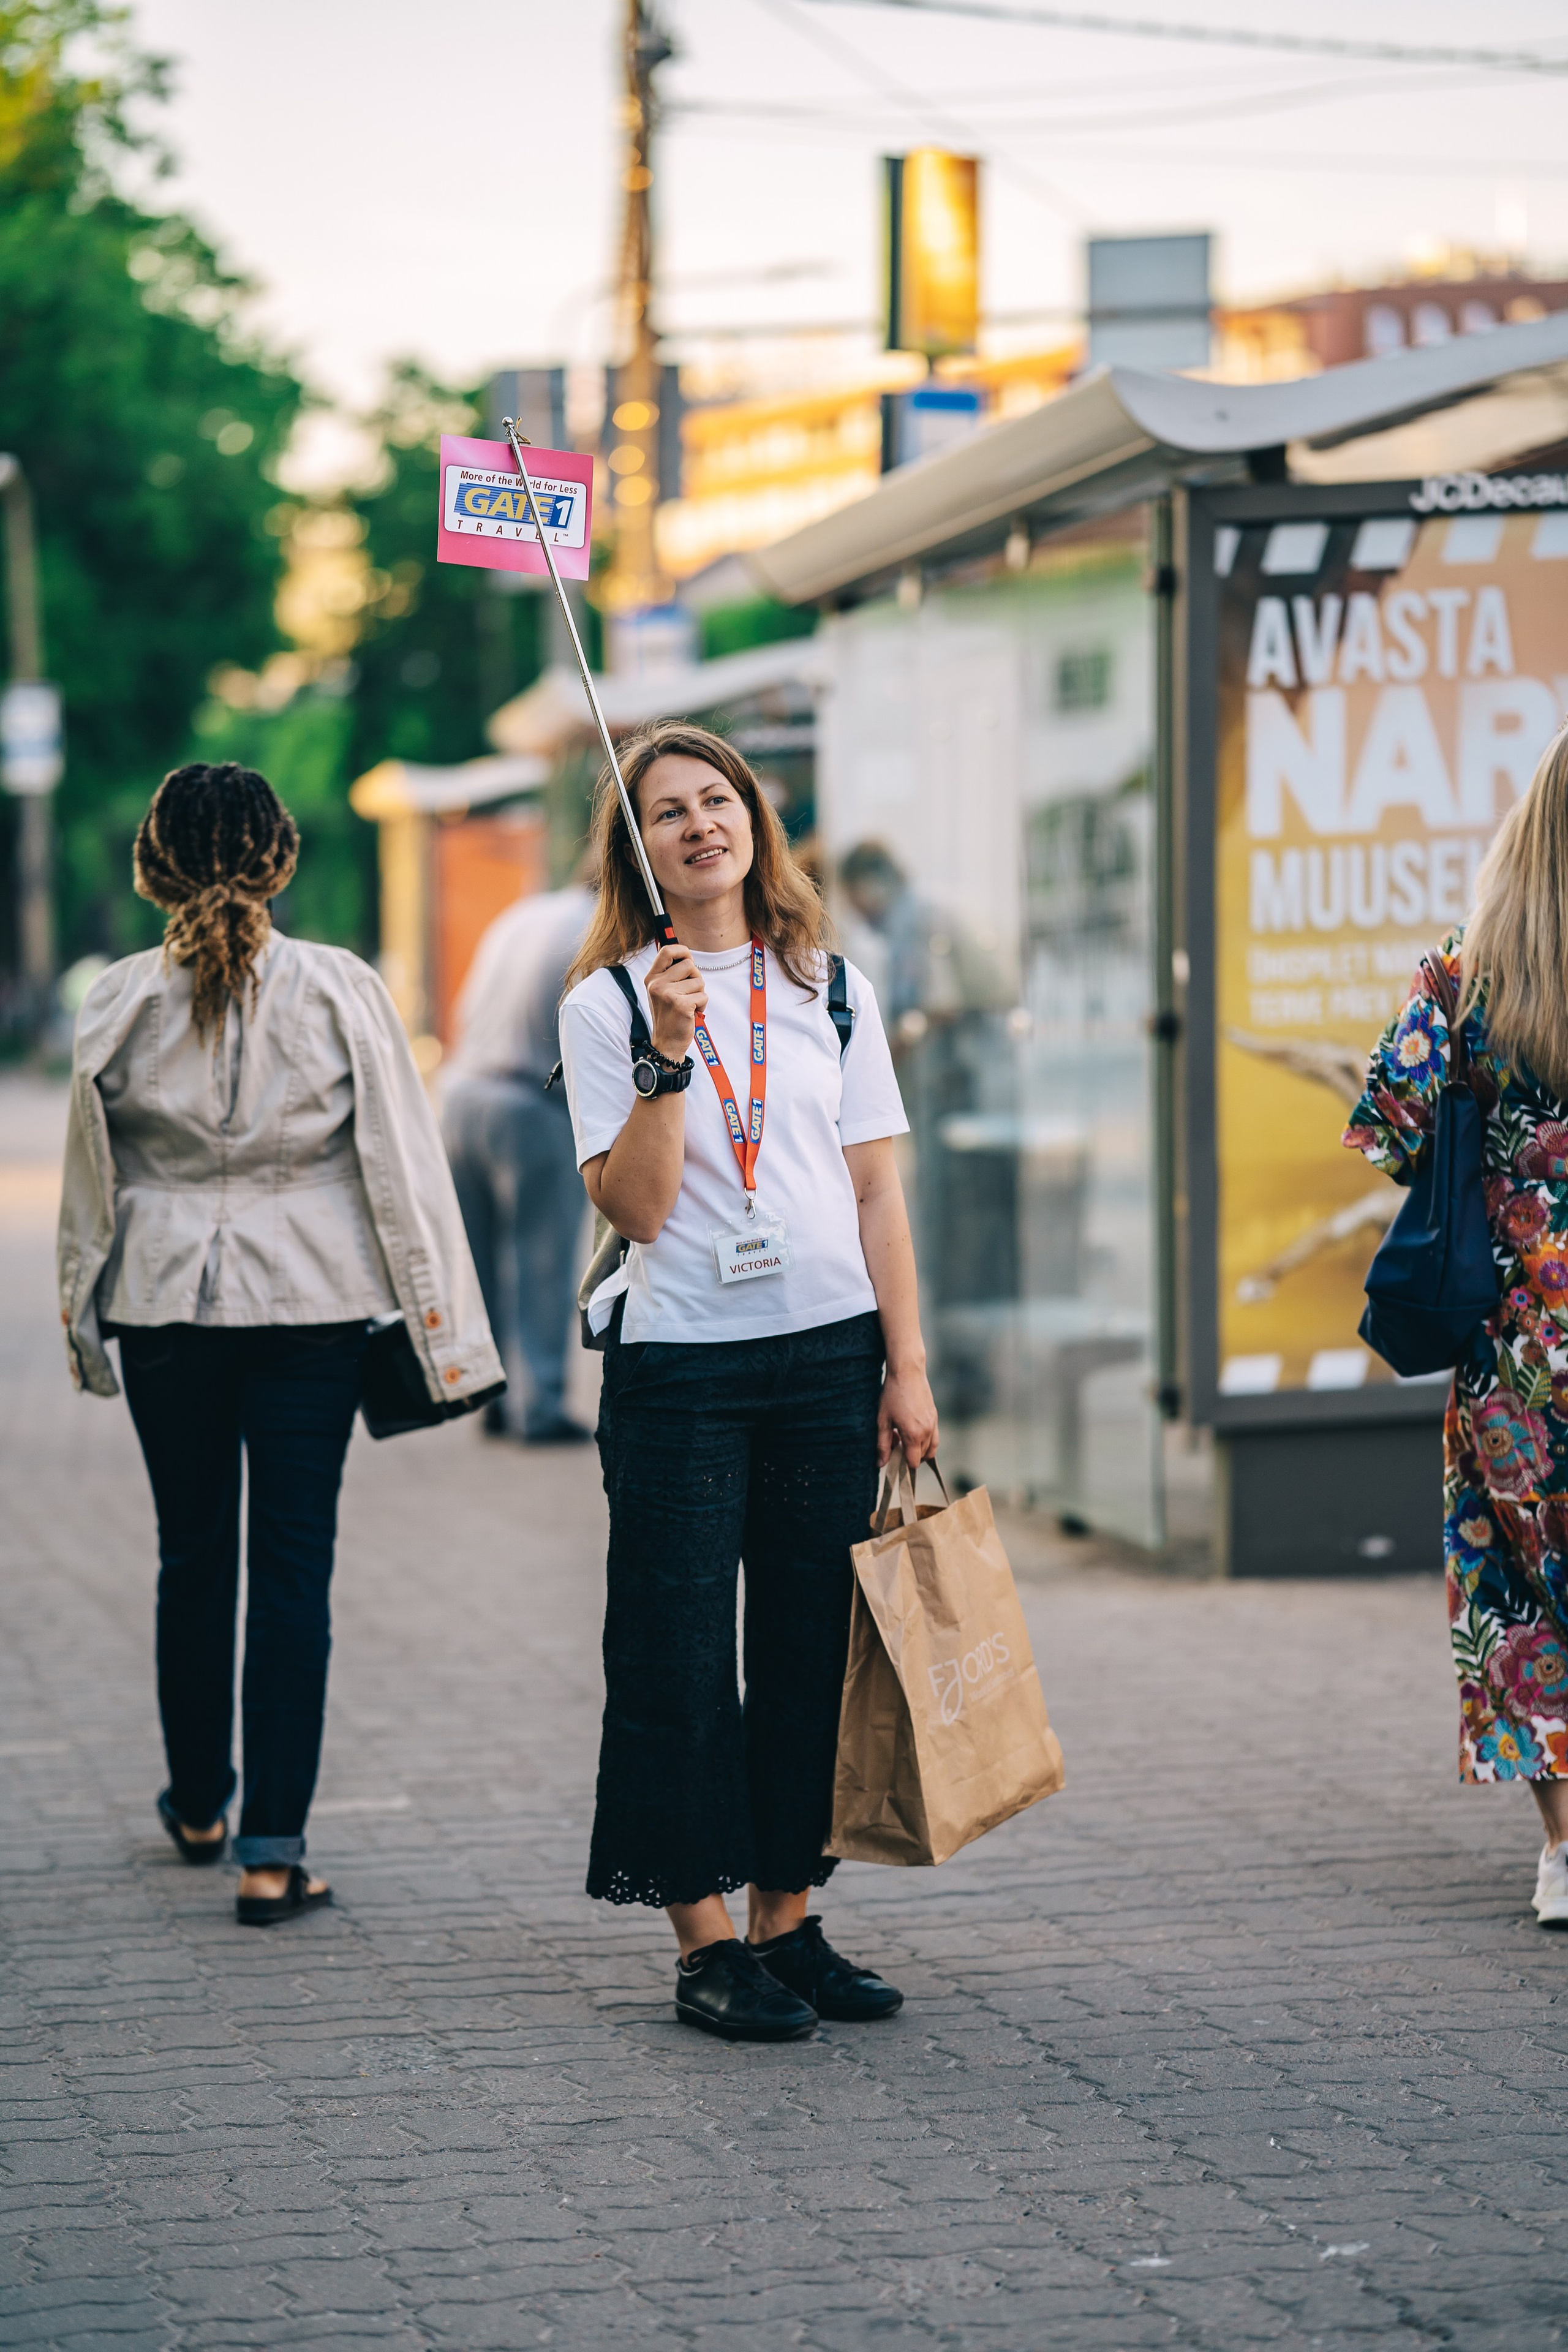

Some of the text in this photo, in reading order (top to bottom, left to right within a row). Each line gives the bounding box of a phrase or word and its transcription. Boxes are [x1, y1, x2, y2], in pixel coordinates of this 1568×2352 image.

[460, 470, 578, 494] More of the Wrld for Less
[464, 487, 553, 523] GATE
[1248, 587, 1514, 687] AVASTA
[1245, 676, 1568, 838] NAR
[753, 954, 764, 987] GATE
[696, 1029, 716, 1060] GATE
[753, 1029, 764, 1061] GATE
[726, 1102, 742, 1136] GATE
[751, 1106, 762, 1140] GATE
[738, 1241, 762, 1252] GATE
[729, 1257, 782, 1274] VICTORIA
